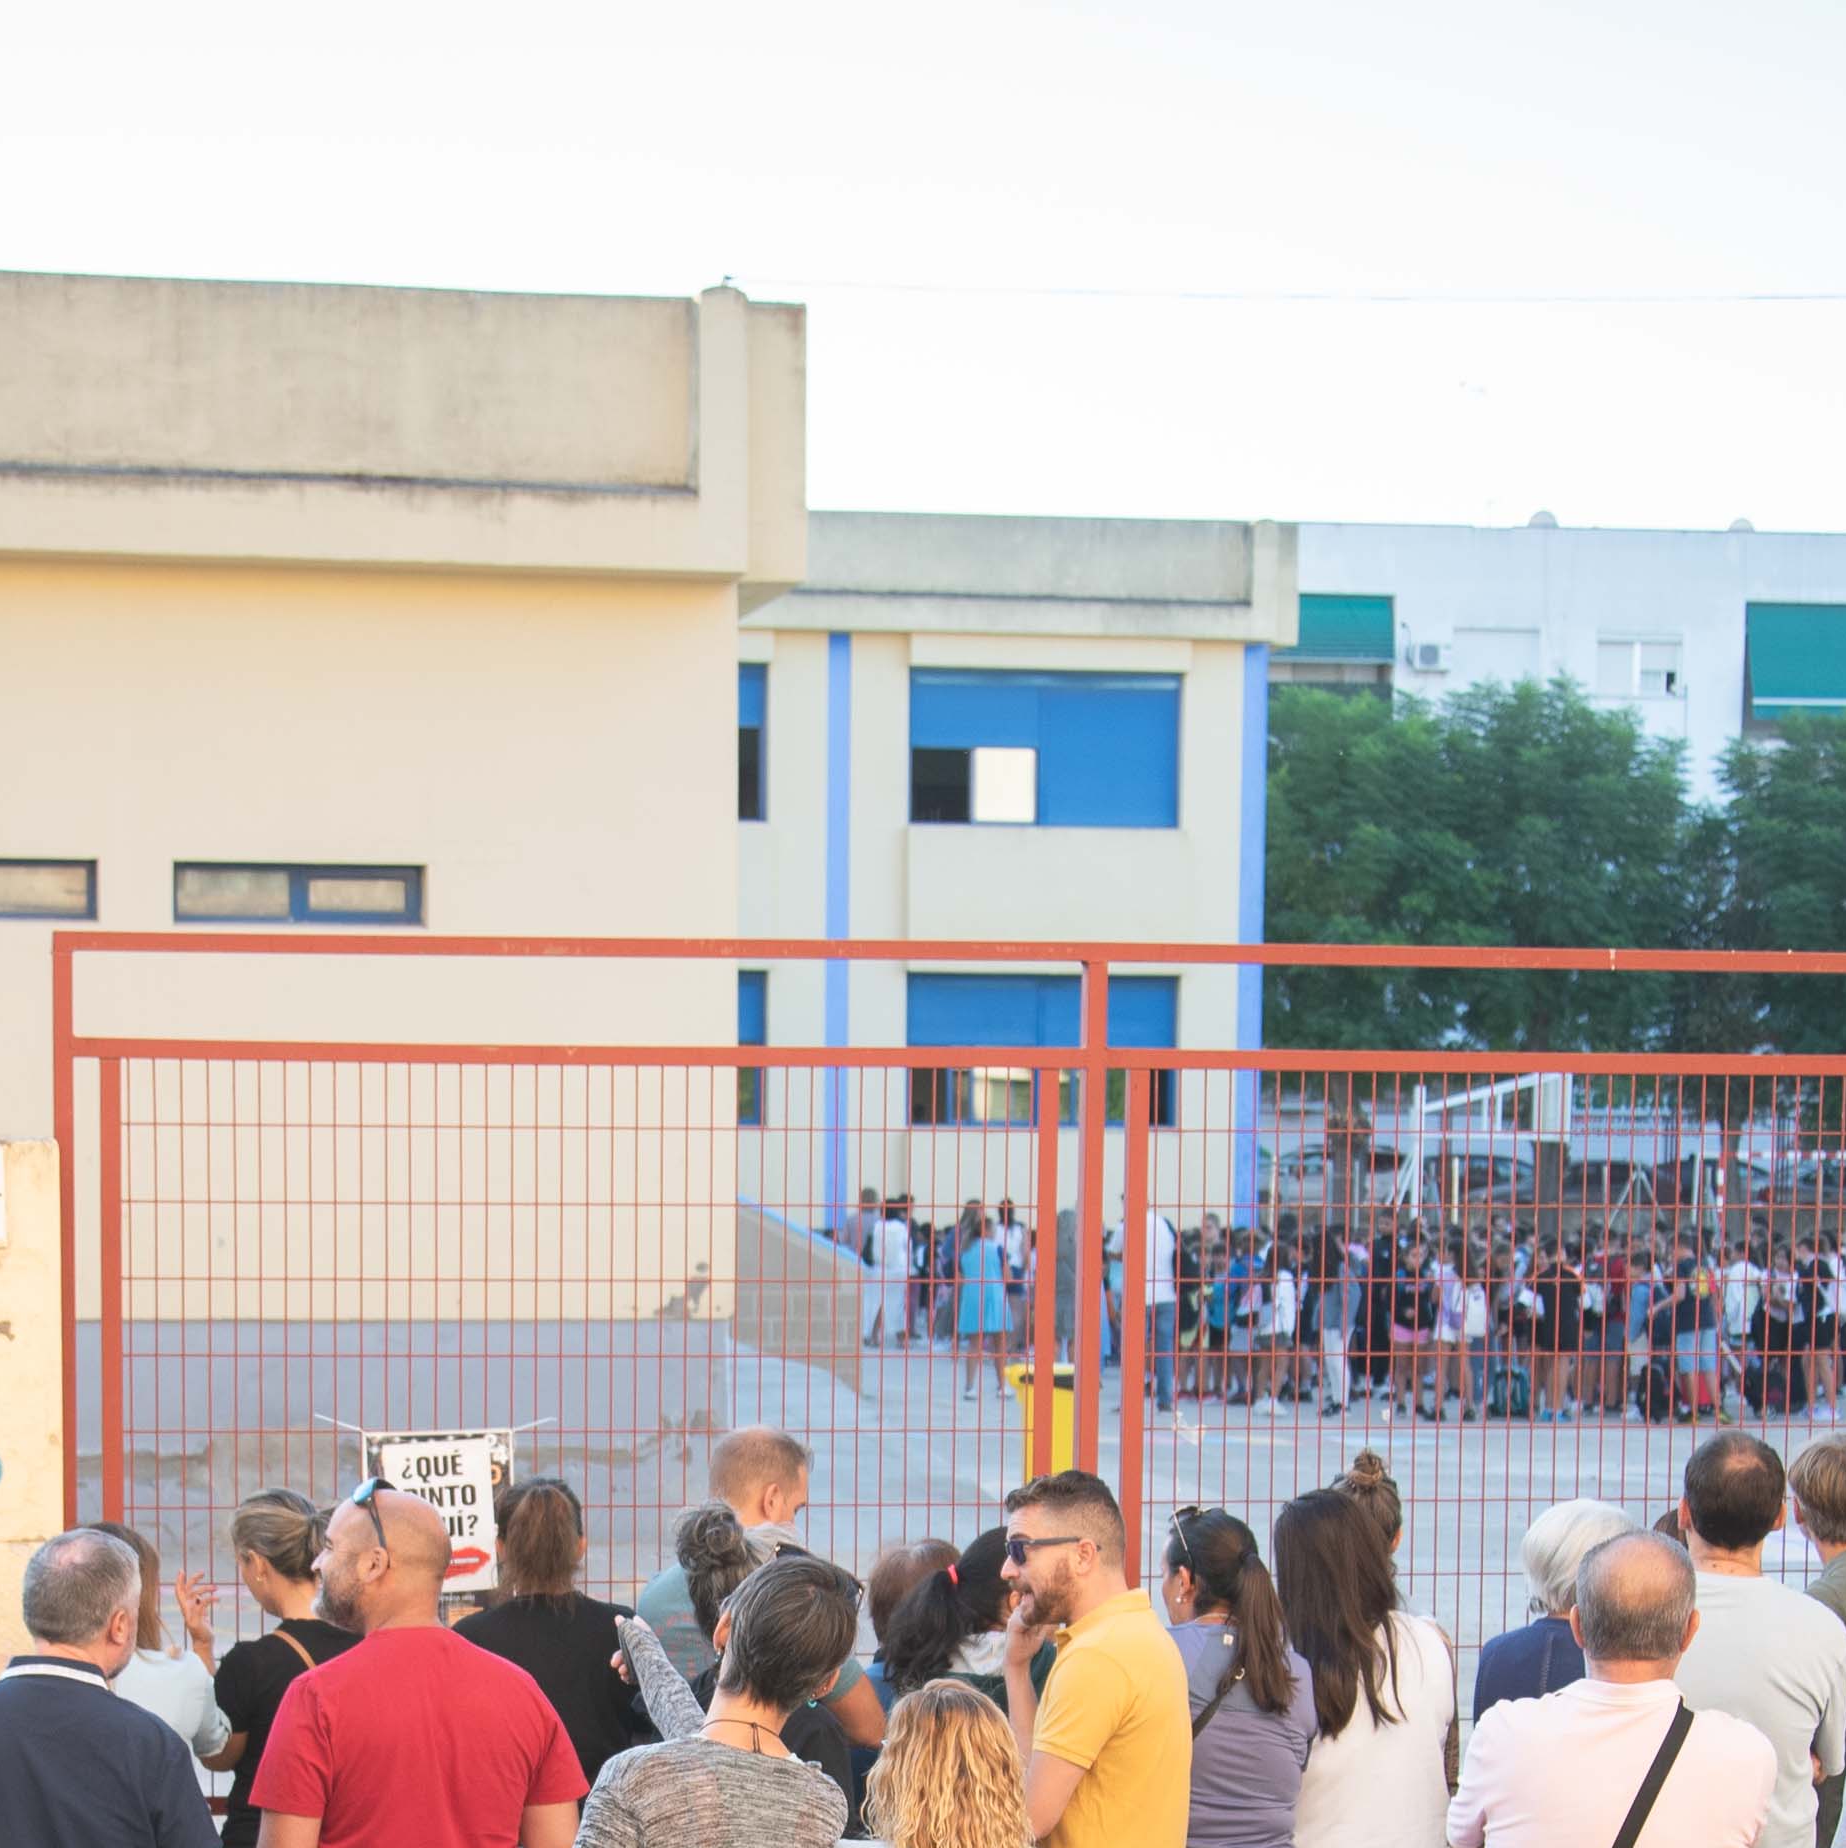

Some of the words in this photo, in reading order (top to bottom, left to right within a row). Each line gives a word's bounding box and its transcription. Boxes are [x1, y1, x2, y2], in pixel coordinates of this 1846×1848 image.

[402, 1449, 465, 1484] ¿QUÉ
[403, 1484, 477, 1508] NTO
[442, 1510, 479, 1537] UÍ?
